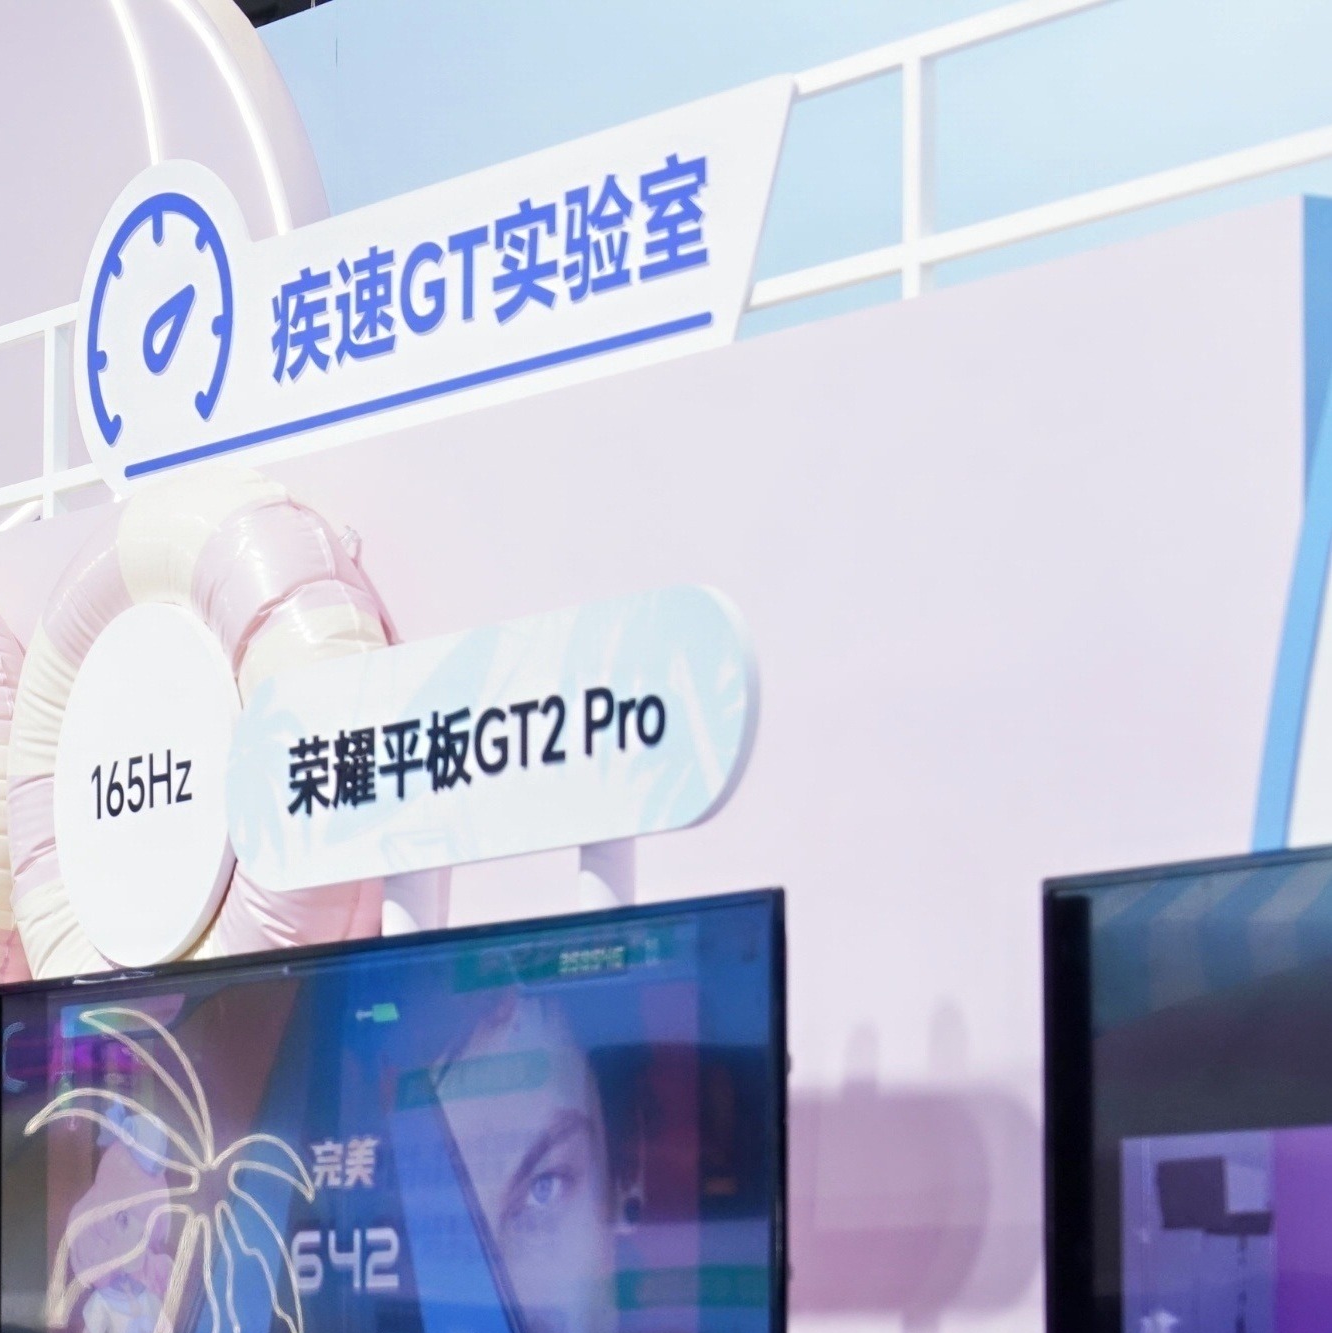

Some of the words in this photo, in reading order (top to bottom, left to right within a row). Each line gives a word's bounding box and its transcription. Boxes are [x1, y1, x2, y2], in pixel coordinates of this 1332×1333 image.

[271, 153, 709, 386] 疾速GT实验室
[91, 748, 193, 820] 165Hz
[288, 693, 567, 818] 荣耀平板GT2
[583, 686, 667, 757] Pro
[310, 1136, 378, 1189] 完美
[291, 1227, 400, 1291] 642
